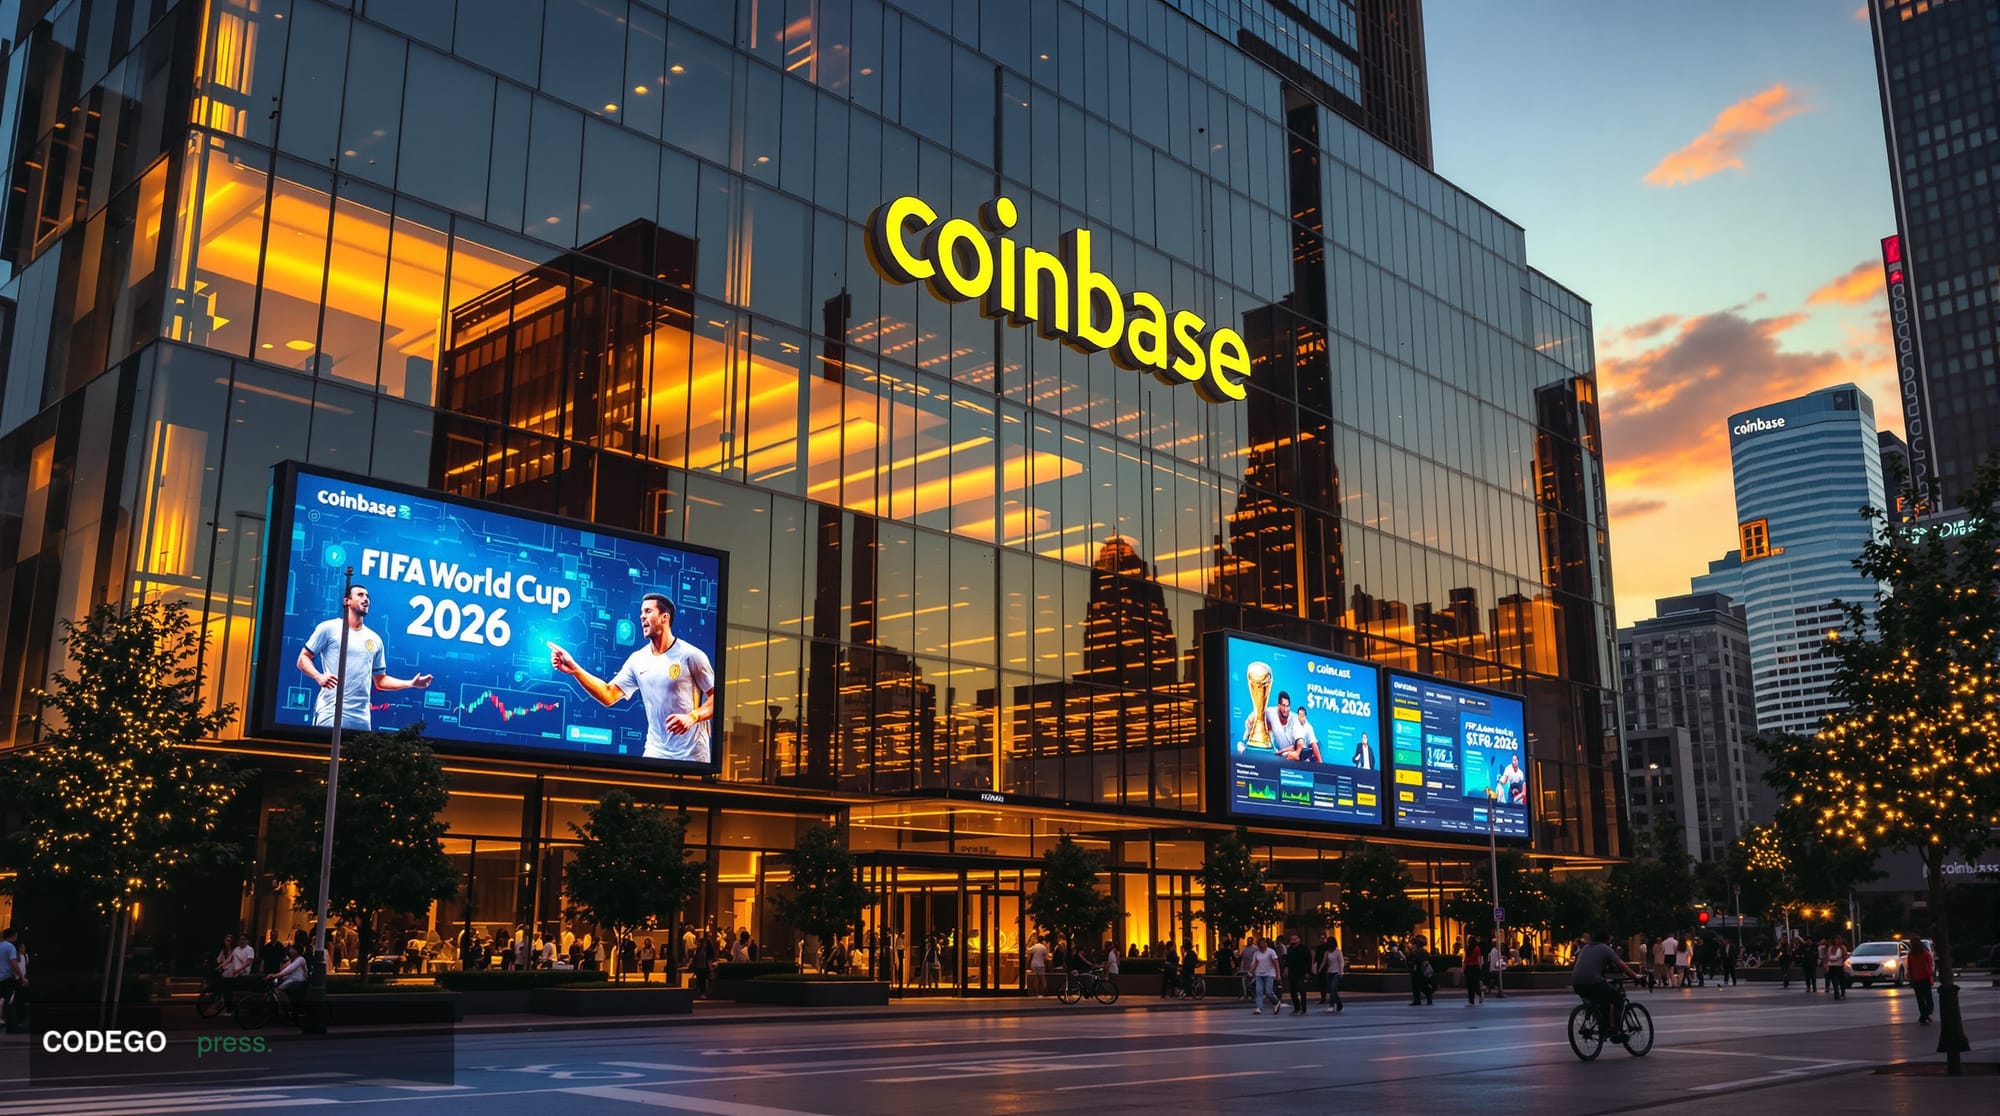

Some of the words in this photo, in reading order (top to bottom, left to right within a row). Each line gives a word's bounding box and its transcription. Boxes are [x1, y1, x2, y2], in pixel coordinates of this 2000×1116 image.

[884, 195, 1251, 401] coinbase
[1733, 417, 1786, 435] coinbase
[317, 490, 397, 518] coinbase
[361, 548, 426, 586] FIFA
[429, 559, 512, 600] World
[516, 574, 571, 614] Cup
[406, 594, 511, 647] 2026
[1341, 698, 1371, 717] 2026
[1493, 735, 1518, 751] 2026
